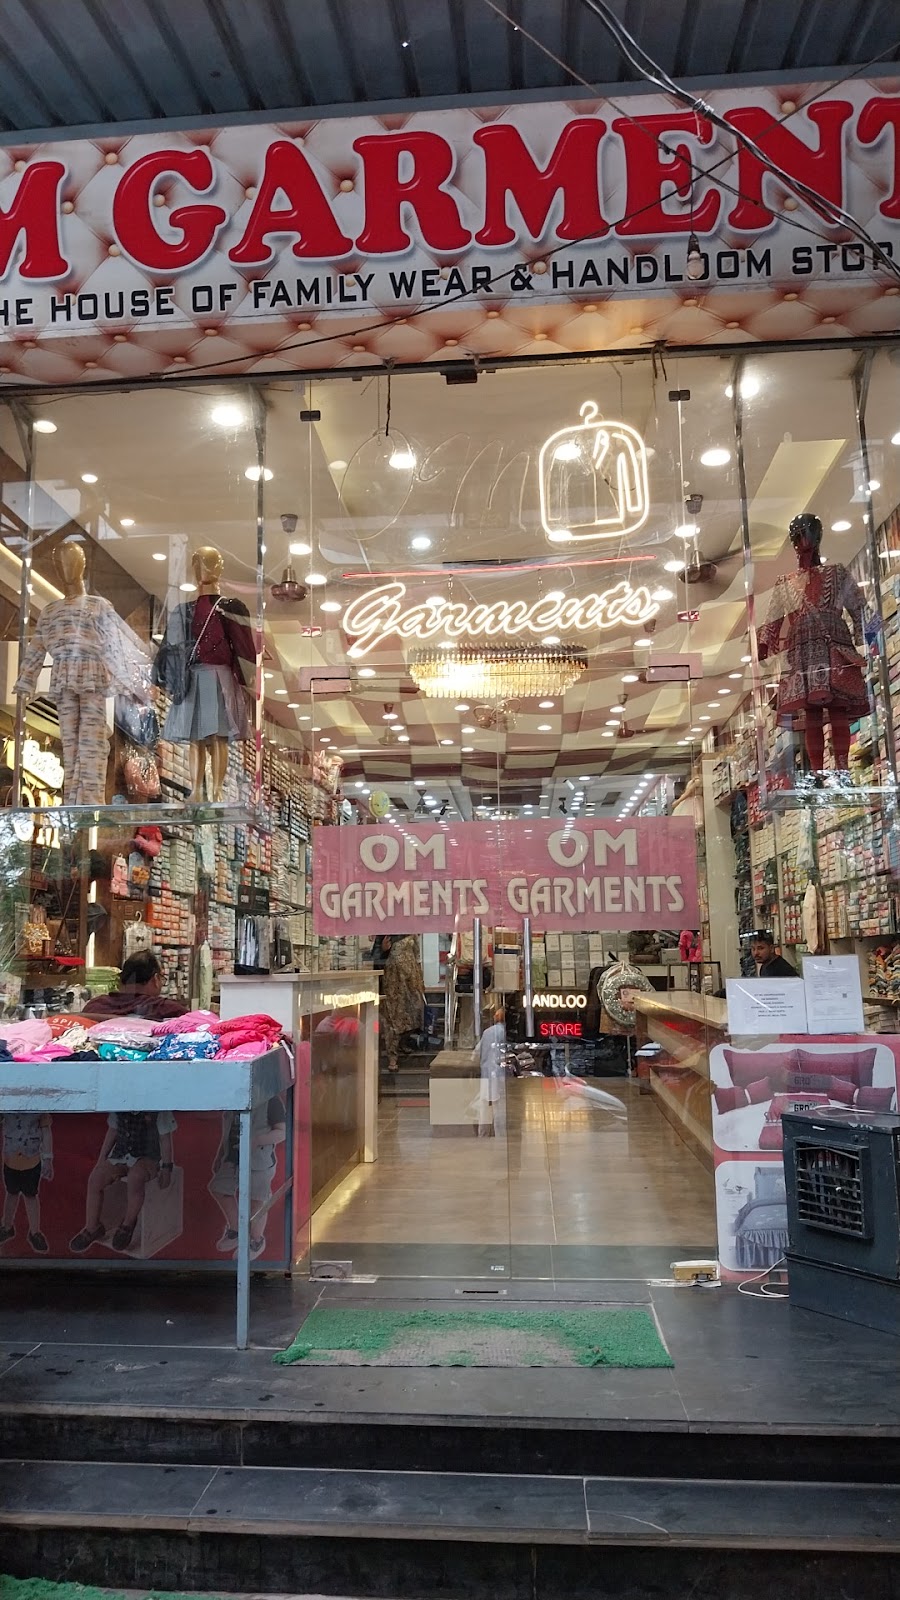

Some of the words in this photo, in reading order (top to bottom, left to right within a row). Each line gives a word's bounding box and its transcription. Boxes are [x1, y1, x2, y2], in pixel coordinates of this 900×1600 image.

[51, 288, 174, 322] HOUSE
[192, 283, 237, 312] OF
[254, 274, 374, 309] FAMILY
[390, 266, 491, 296] WEAR
[510, 263, 533, 291] &
[359, 833, 447, 873] OM
[547, 828, 638, 869] OM
[319, 878, 490, 922] GARMENTS
[506, 875, 685, 918] GARMENTS
[540, 1023, 582, 1036] STORE
